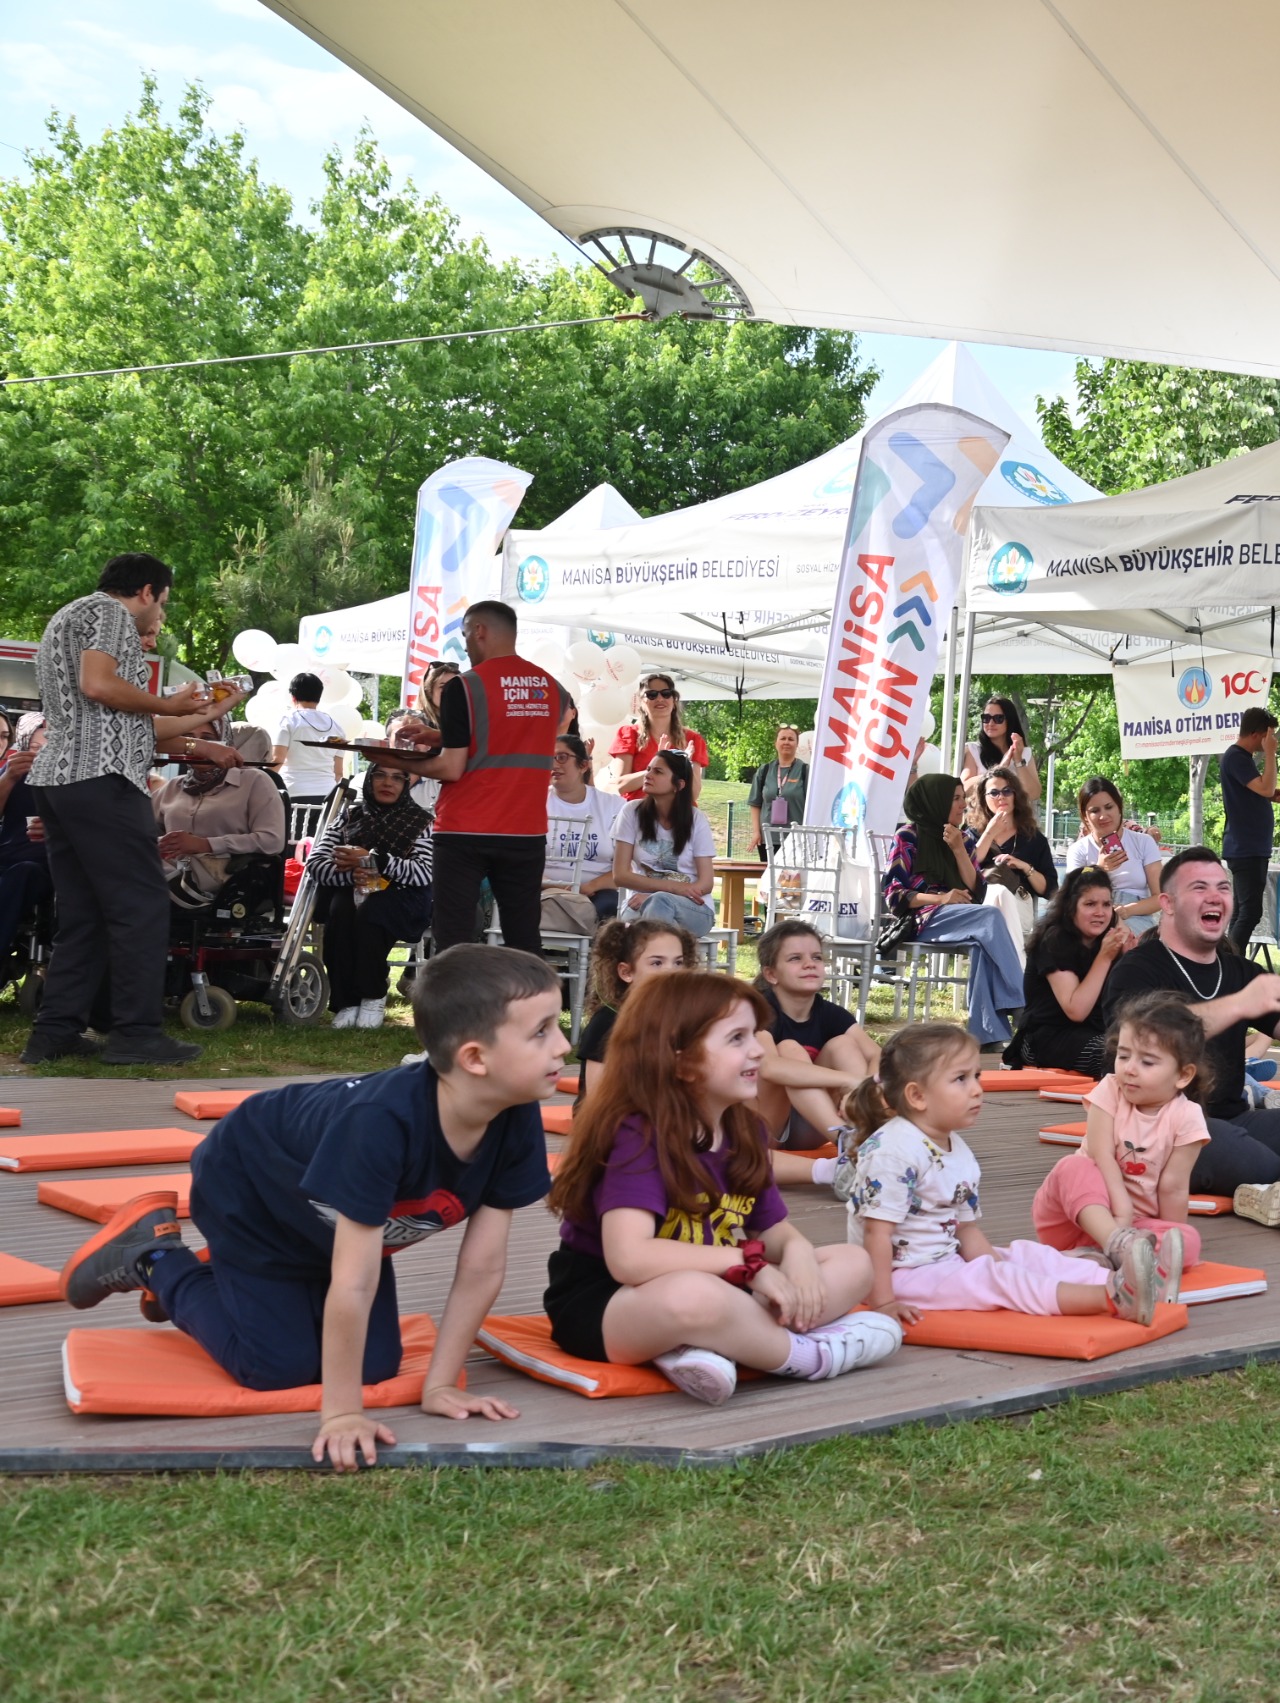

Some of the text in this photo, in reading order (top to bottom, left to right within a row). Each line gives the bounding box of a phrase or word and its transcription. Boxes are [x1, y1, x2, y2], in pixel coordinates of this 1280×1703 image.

[562, 555, 780, 586] MANİSA BÜYÜKŞEHİR BELEDİYESİ
[1046, 553, 1119, 577] MANİSA
[1119, 540, 1233, 573] BÜYÜKŞEHİR
[1123, 716, 1172, 736] MANİSA
[1176, 712, 1212, 733] OTİZM
